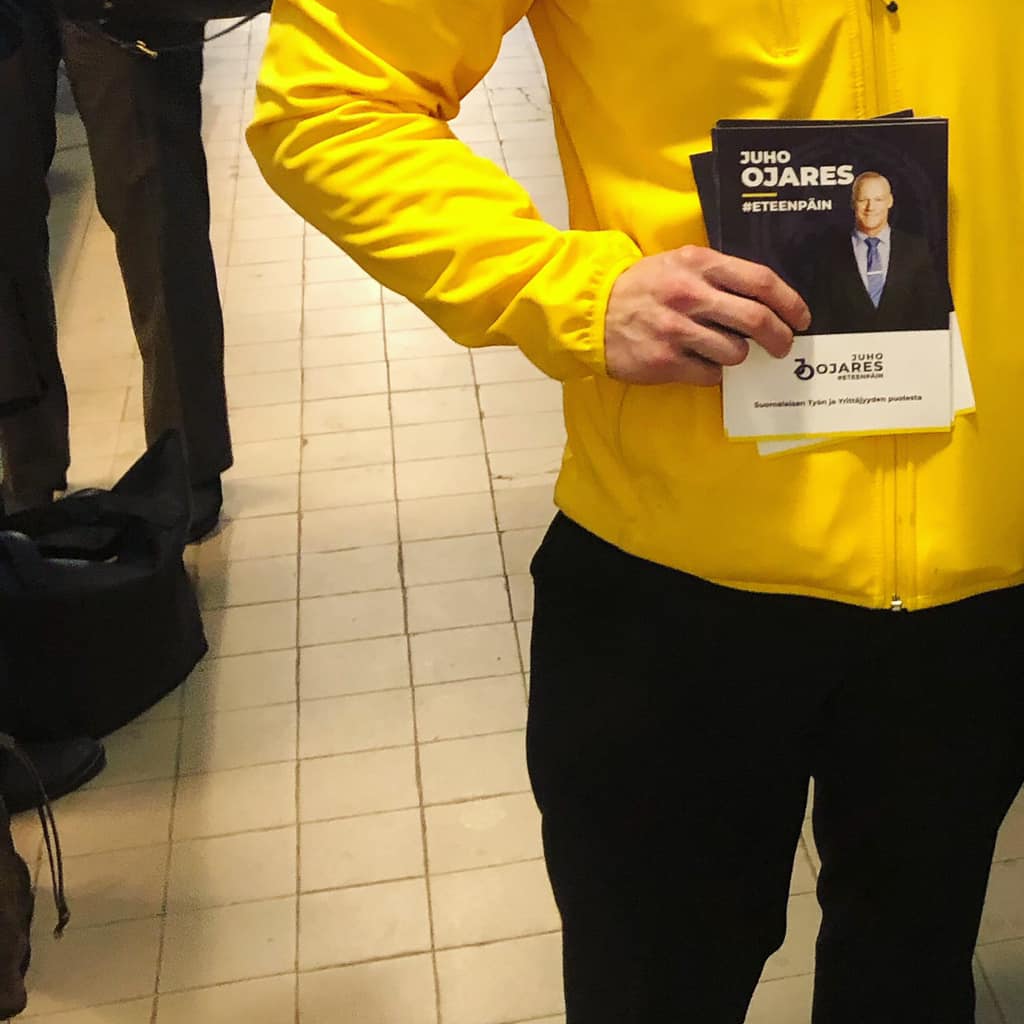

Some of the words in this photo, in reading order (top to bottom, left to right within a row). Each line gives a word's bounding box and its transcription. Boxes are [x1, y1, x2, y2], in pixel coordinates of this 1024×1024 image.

[739, 150, 791, 165] JUHO
[741, 164, 854, 187] OJARES
[741, 197, 832, 213] #ETEENPÄIN
[851, 352, 884, 361] JUHO
[816, 361, 884, 375] OJARES
[754, 399, 806, 409] Suomalaisen
[808, 399, 827, 407] Työn
[839, 396, 886, 405] Yrittäjyyden
[888, 394, 922, 403] puolesta
